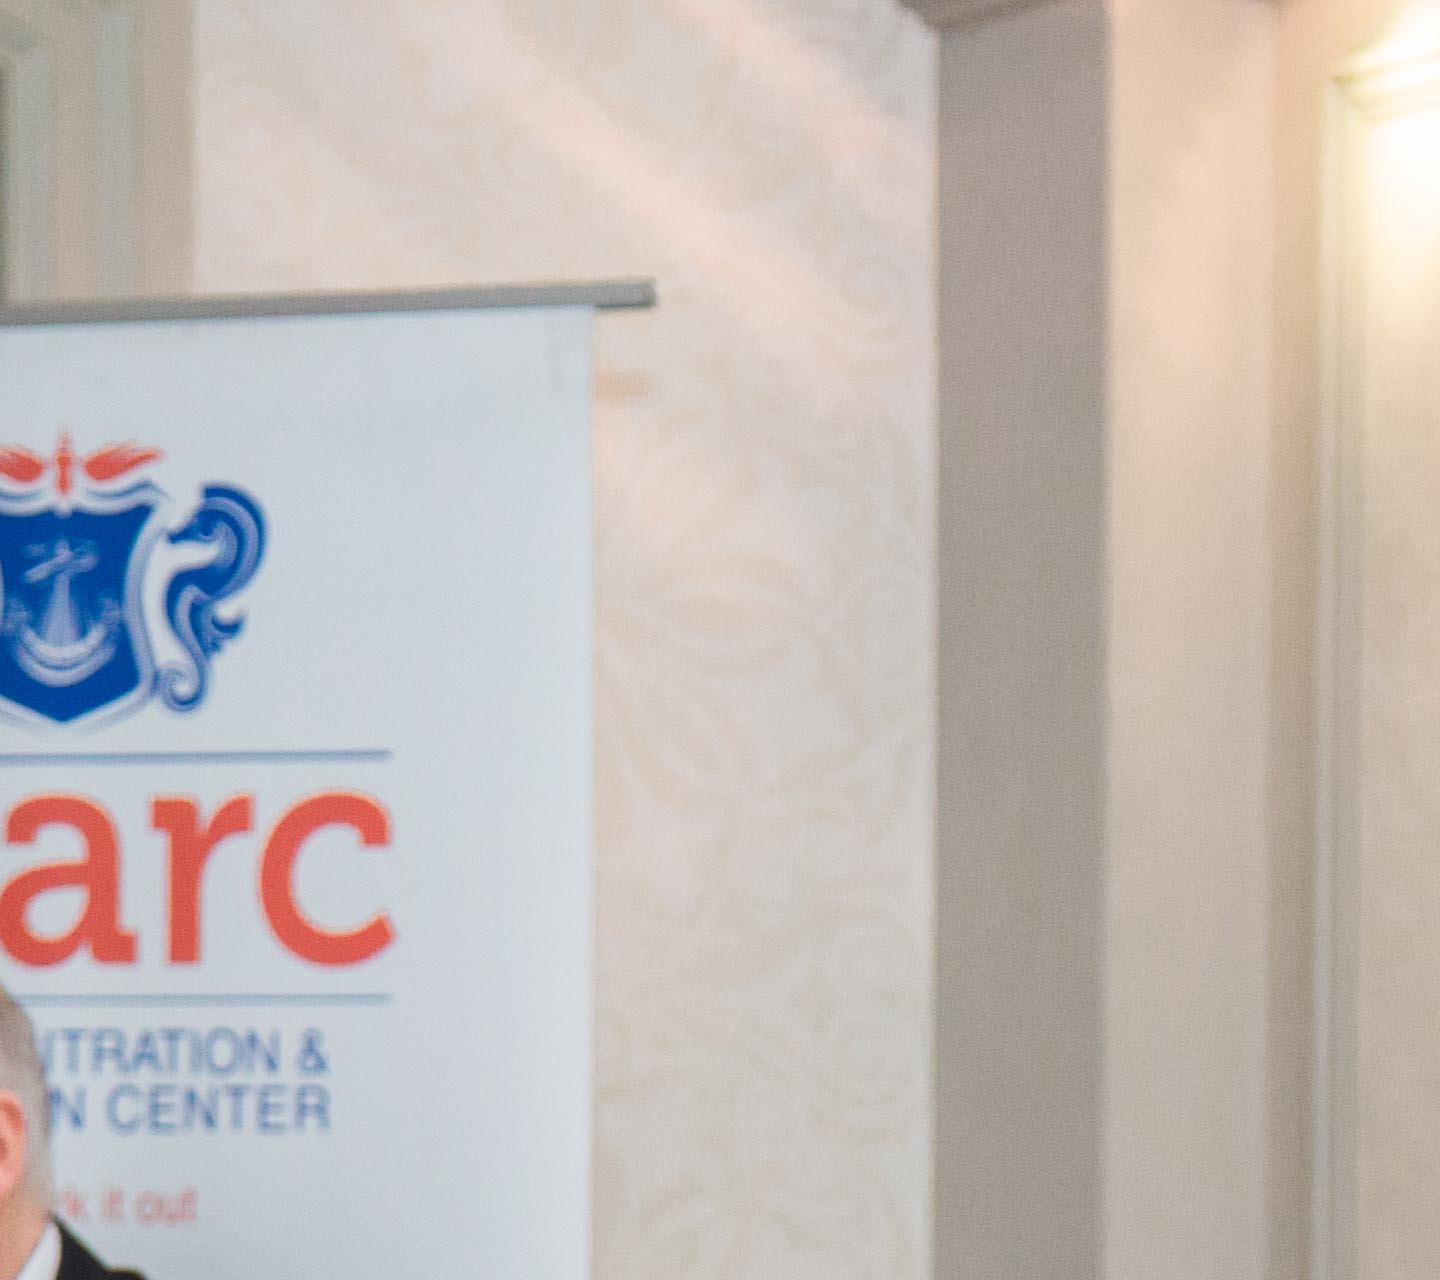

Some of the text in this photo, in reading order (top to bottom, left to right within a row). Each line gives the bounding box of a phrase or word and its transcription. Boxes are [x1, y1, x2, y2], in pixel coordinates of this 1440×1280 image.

[297, 1026, 330, 1075] &
[107, 1082, 332, 1135] CENTER
[135, 1185, 199, 1227] out
